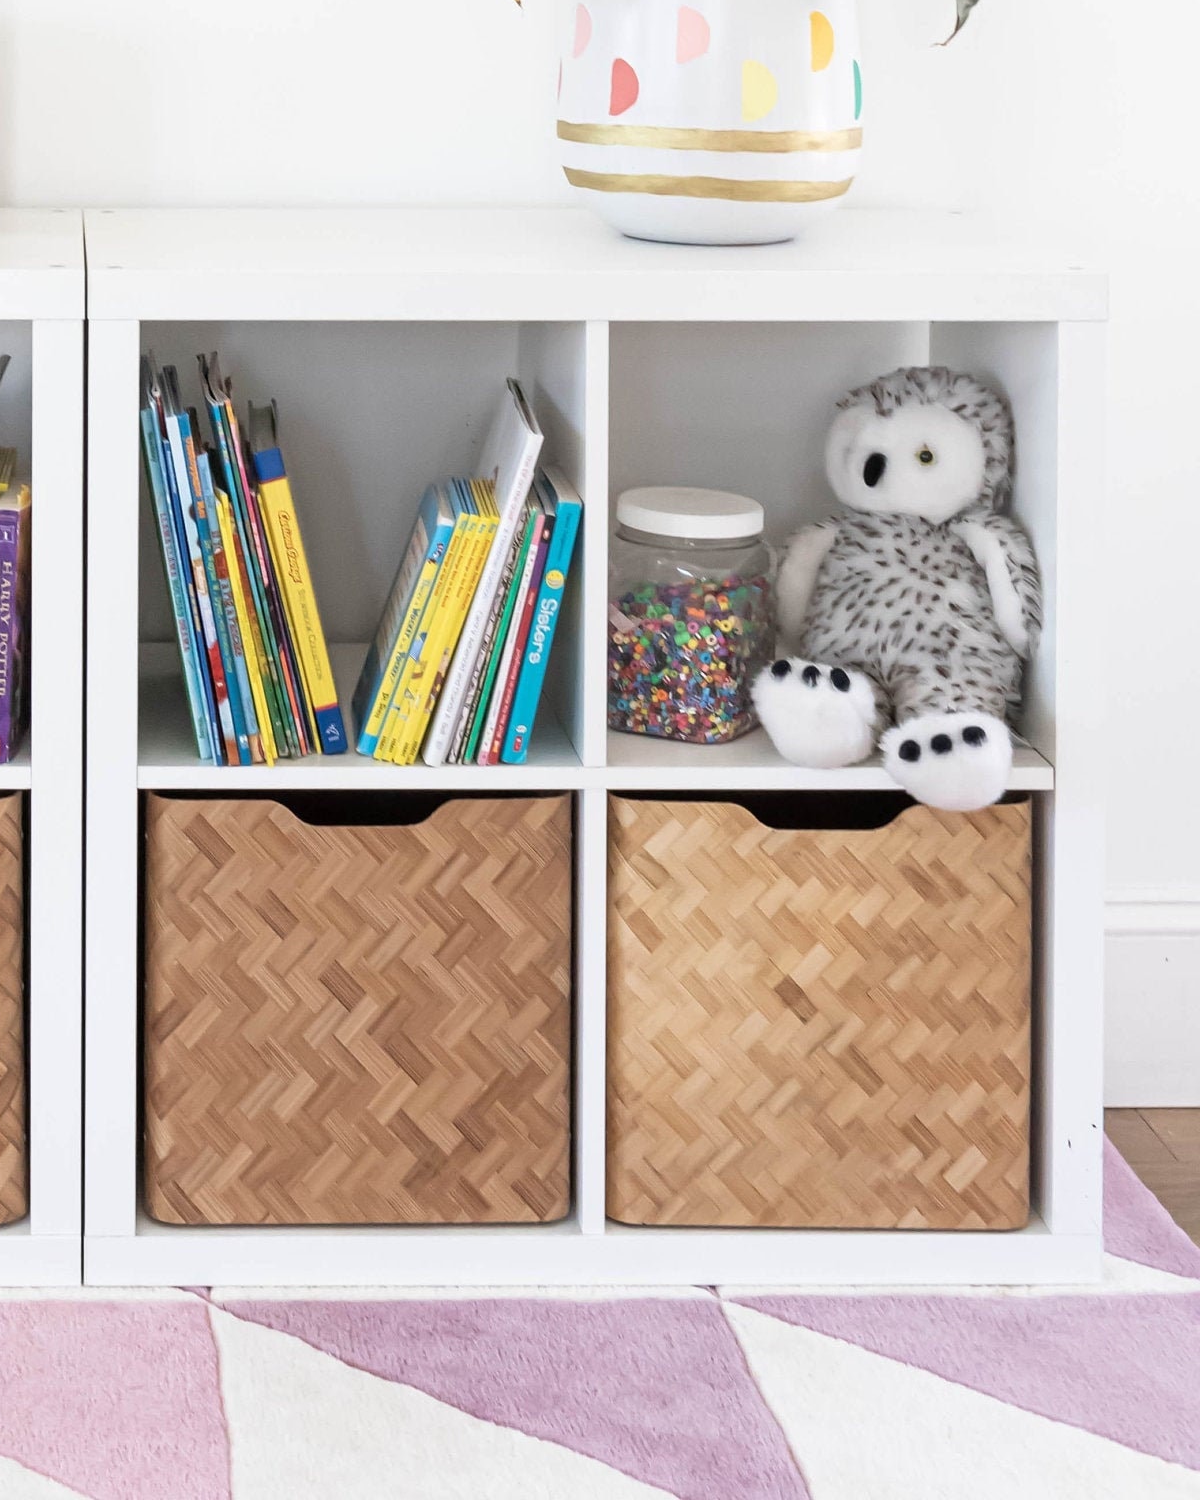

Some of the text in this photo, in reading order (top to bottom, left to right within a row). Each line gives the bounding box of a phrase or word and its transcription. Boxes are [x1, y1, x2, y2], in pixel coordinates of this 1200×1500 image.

[278, 510, 304, 584] Curious George
[0, 560, 13, 625] HARRY
[528, 598, 558, 664] Sisters
